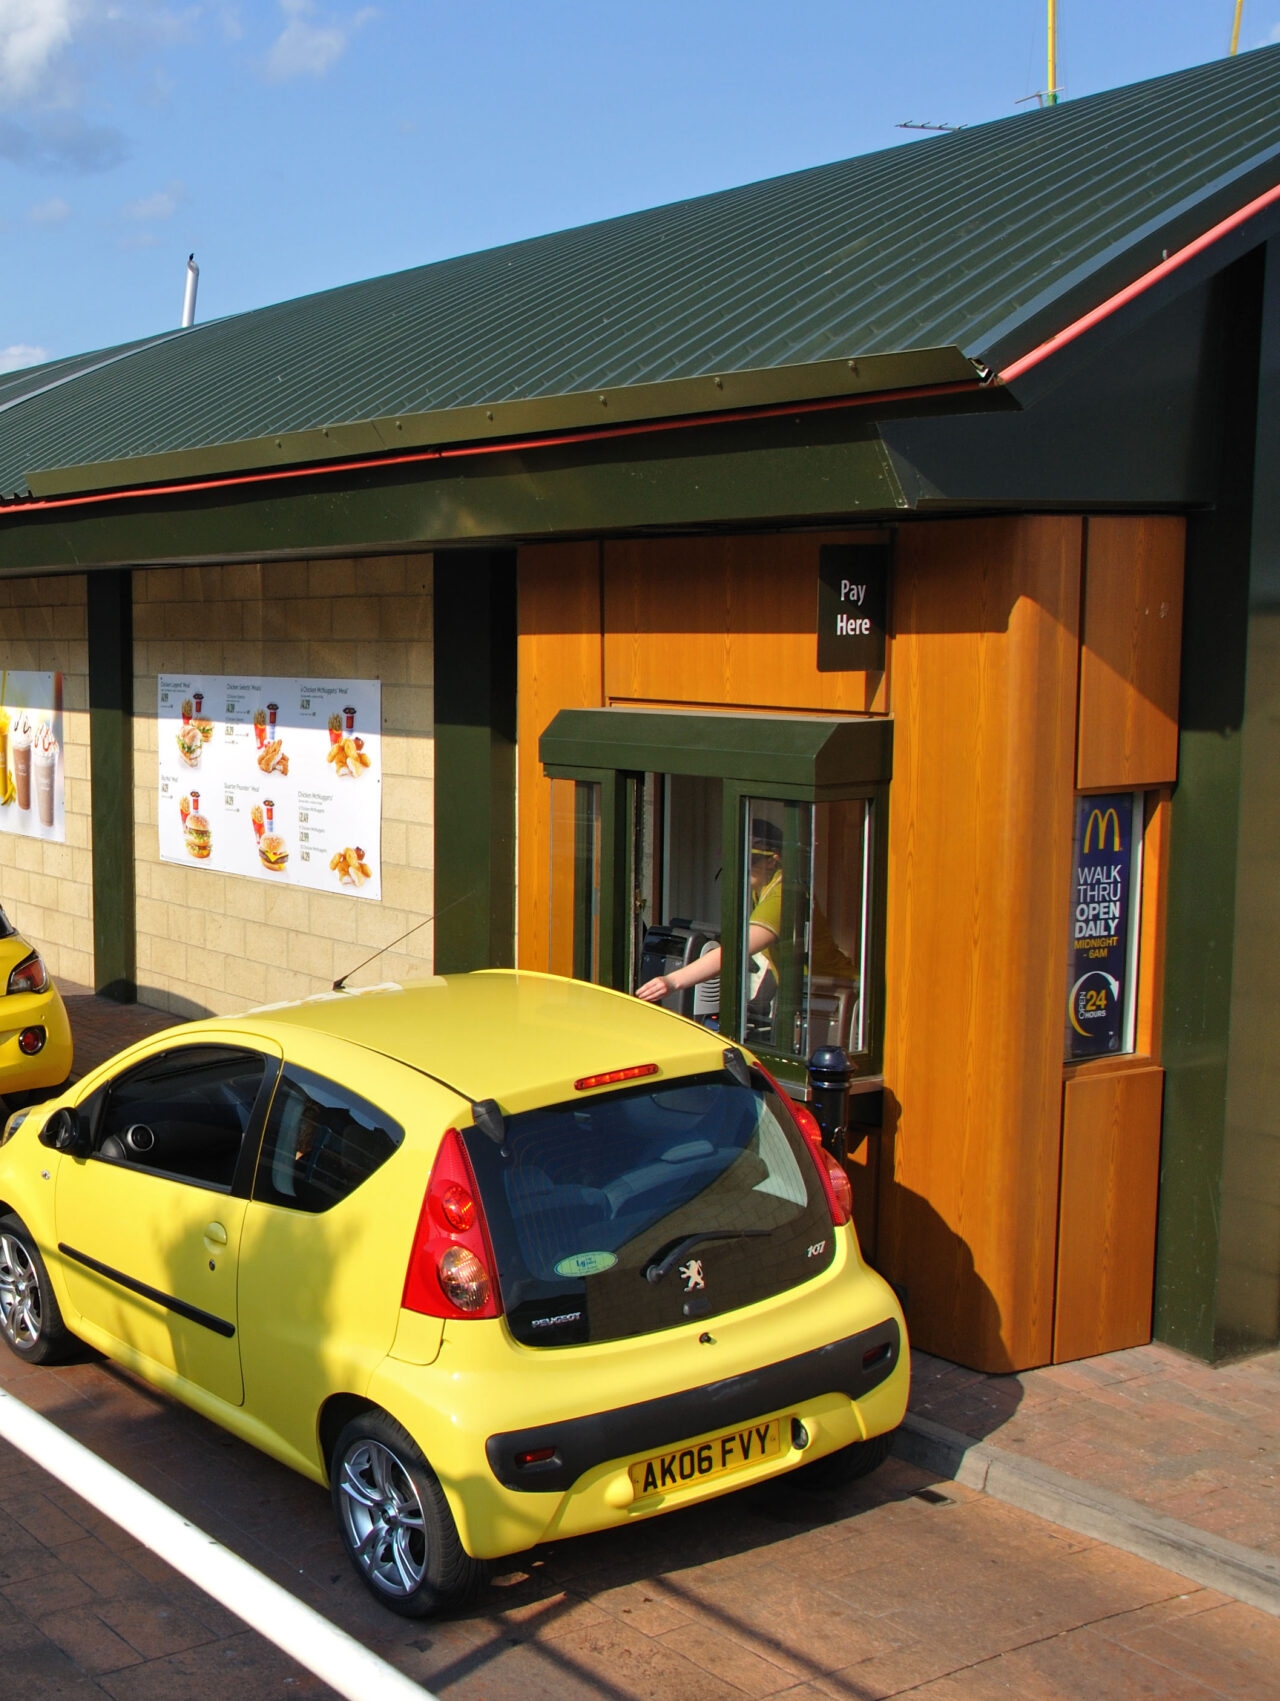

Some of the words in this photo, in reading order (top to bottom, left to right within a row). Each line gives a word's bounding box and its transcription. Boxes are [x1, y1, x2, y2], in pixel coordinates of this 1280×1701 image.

[840, 579, 867, 606] Pay
[836, 613, 871, 636] Here
[1078, 865, 1122, 884] WALK
[1077, 883, 1121, 902] THRU
[1076, 901, 1120, 921] OPEN
[1075, 919, 1119, 938] DAILY
[1074, 936, 1119, 950] MIDNIGHT
[1089, 947, 1108, 959] 6AM
[1078, 991, 1087, 1020] OPEN
[1085, 990, 1107, 1011] 24
[1084, 1009, 1107, 1019] HOURS
[807, 1240, 826, 1258] 107
[531, 1311, 582, 1329] PEUGEOT
[643, 1444, 713, 1493] AK06
[721, 1424, 770, 1468] FVY
